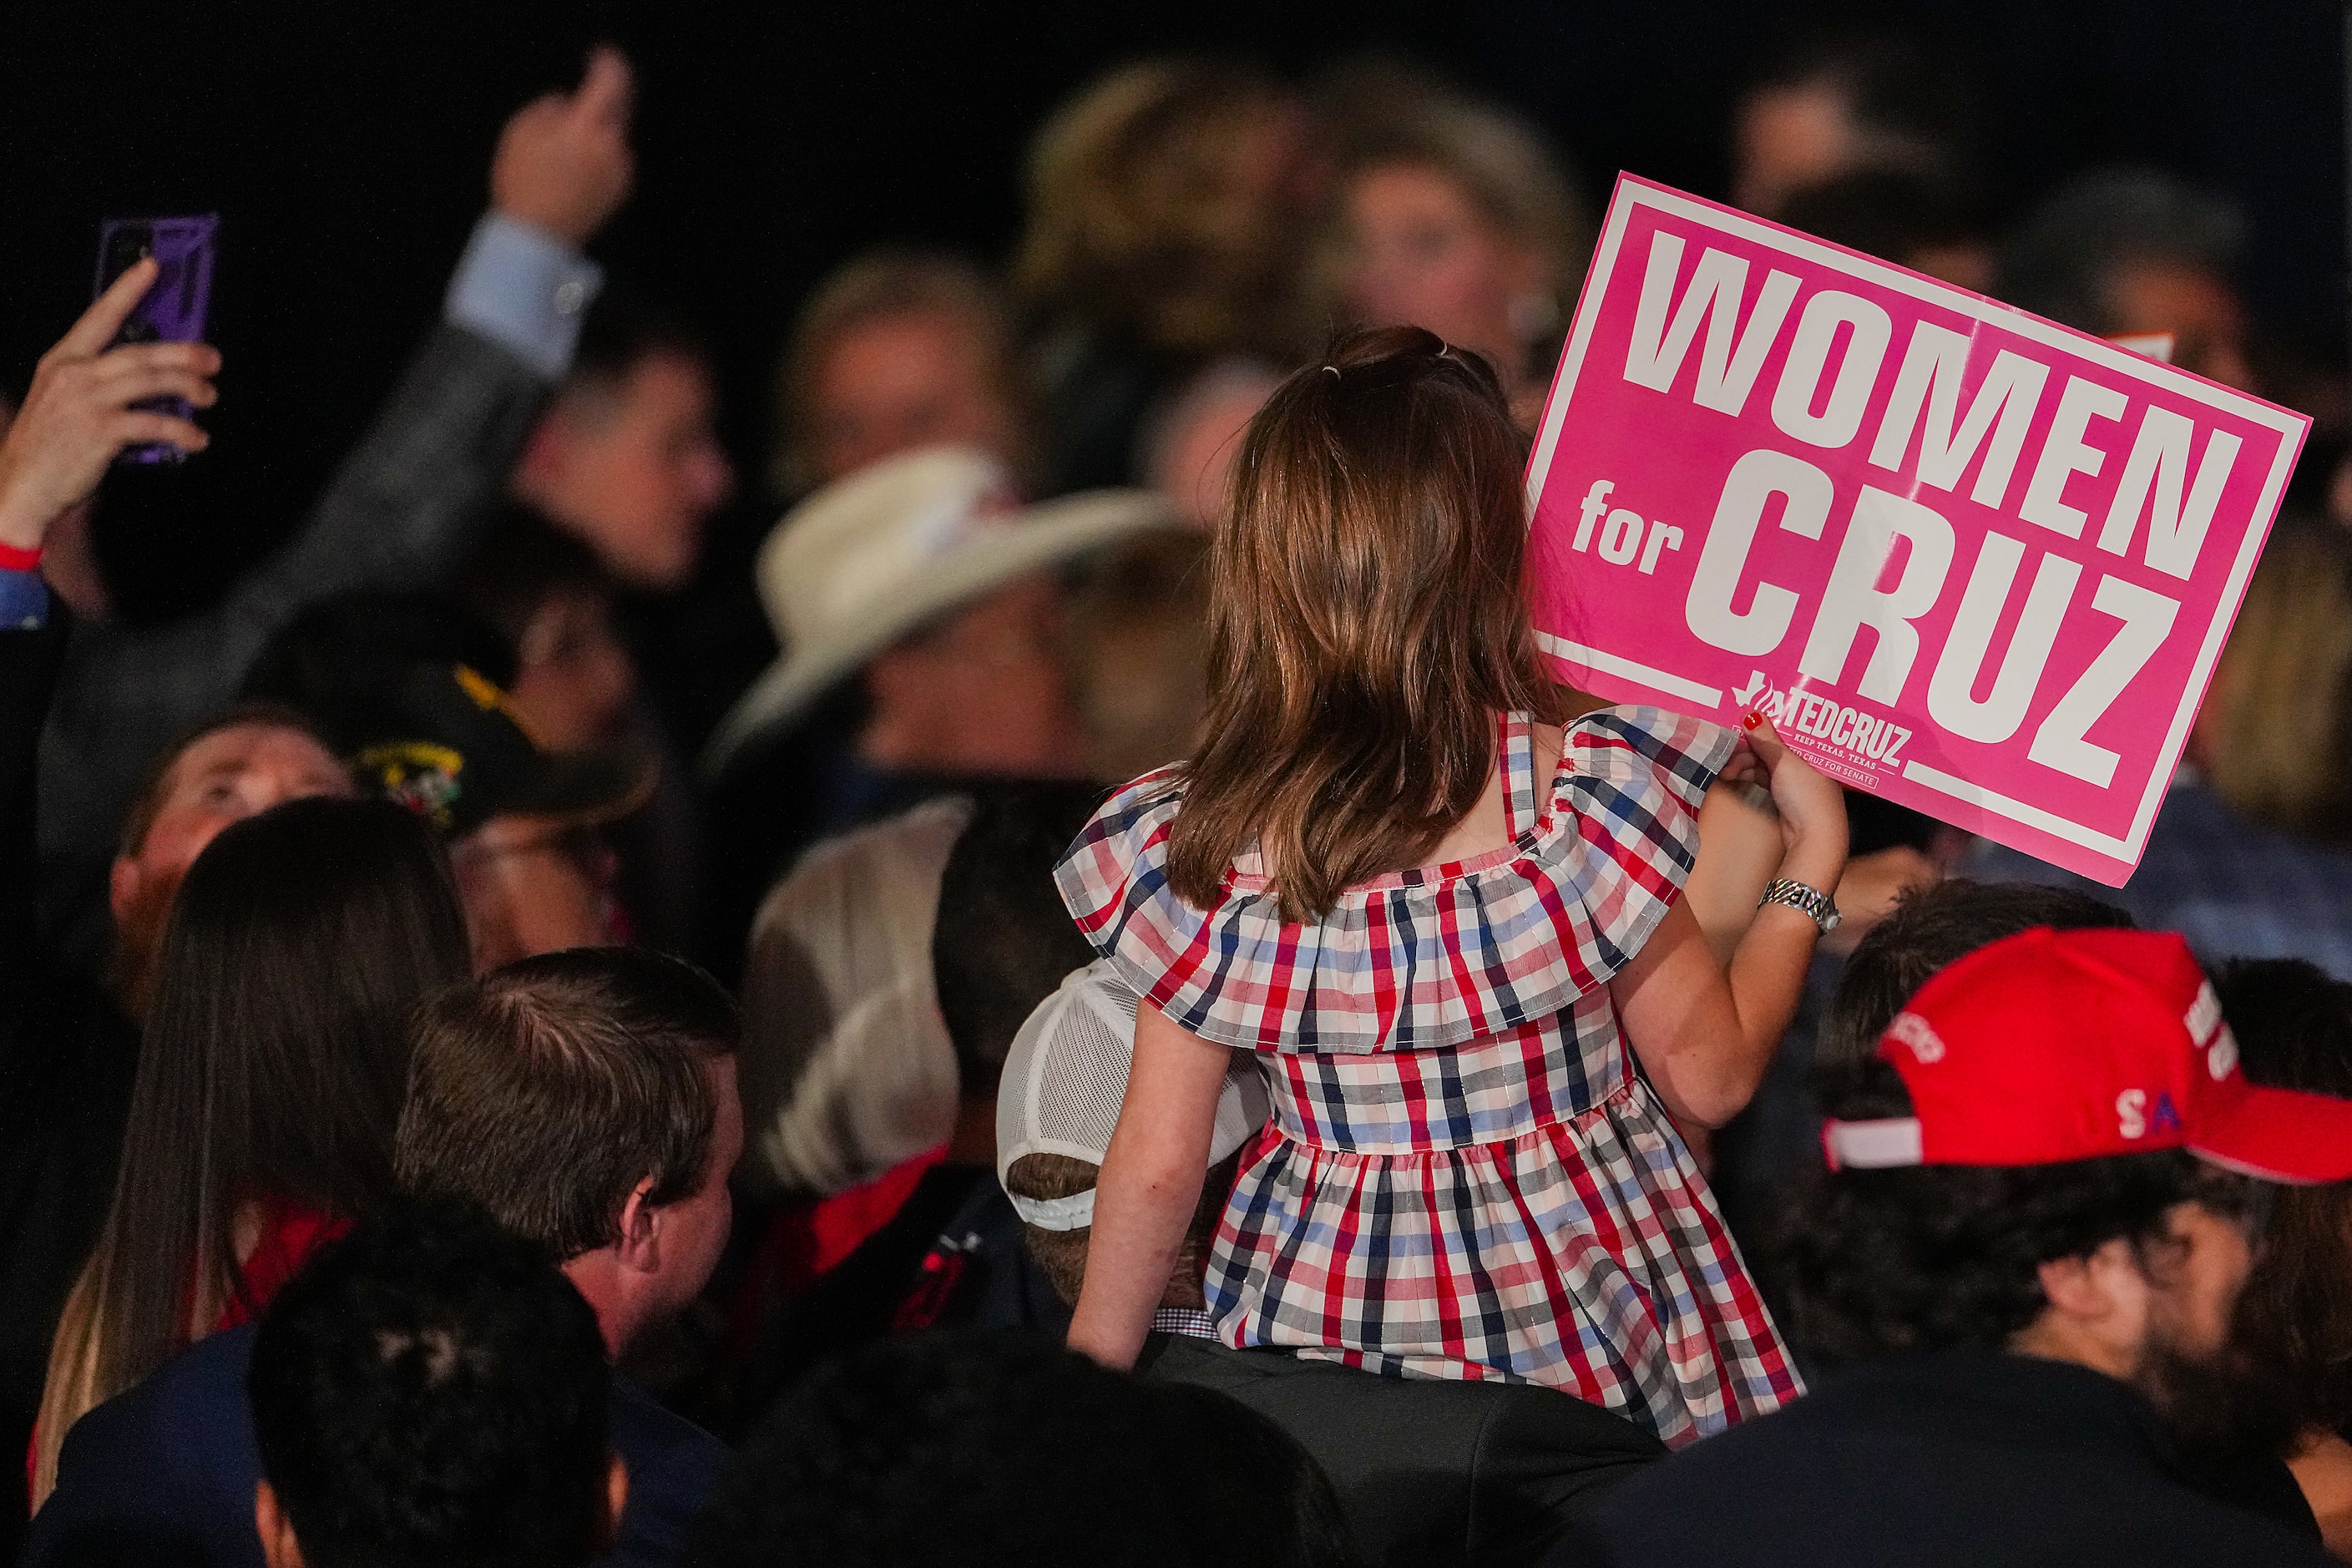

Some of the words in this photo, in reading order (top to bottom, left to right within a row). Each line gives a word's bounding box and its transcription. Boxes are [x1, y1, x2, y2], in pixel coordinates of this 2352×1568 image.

[1623, 230, 2243, 582] WOMEN
[1572, 480, 1684, 575] for
[1686, 449, 2182, 790] CRUZ
[1783, 686, 1913, 768] TEDCRUZ
[1794, 733, 1816, 746] KEEP
[1817, 741, 1845, 759] TEXAS,
[1849, 753, 1877, 770] TEXAS
[1803, 753, 1824, 766] CRUZ
[1824, 761, 1842, 773] FOR
[1843, 767, 1874, 785] SENATE
